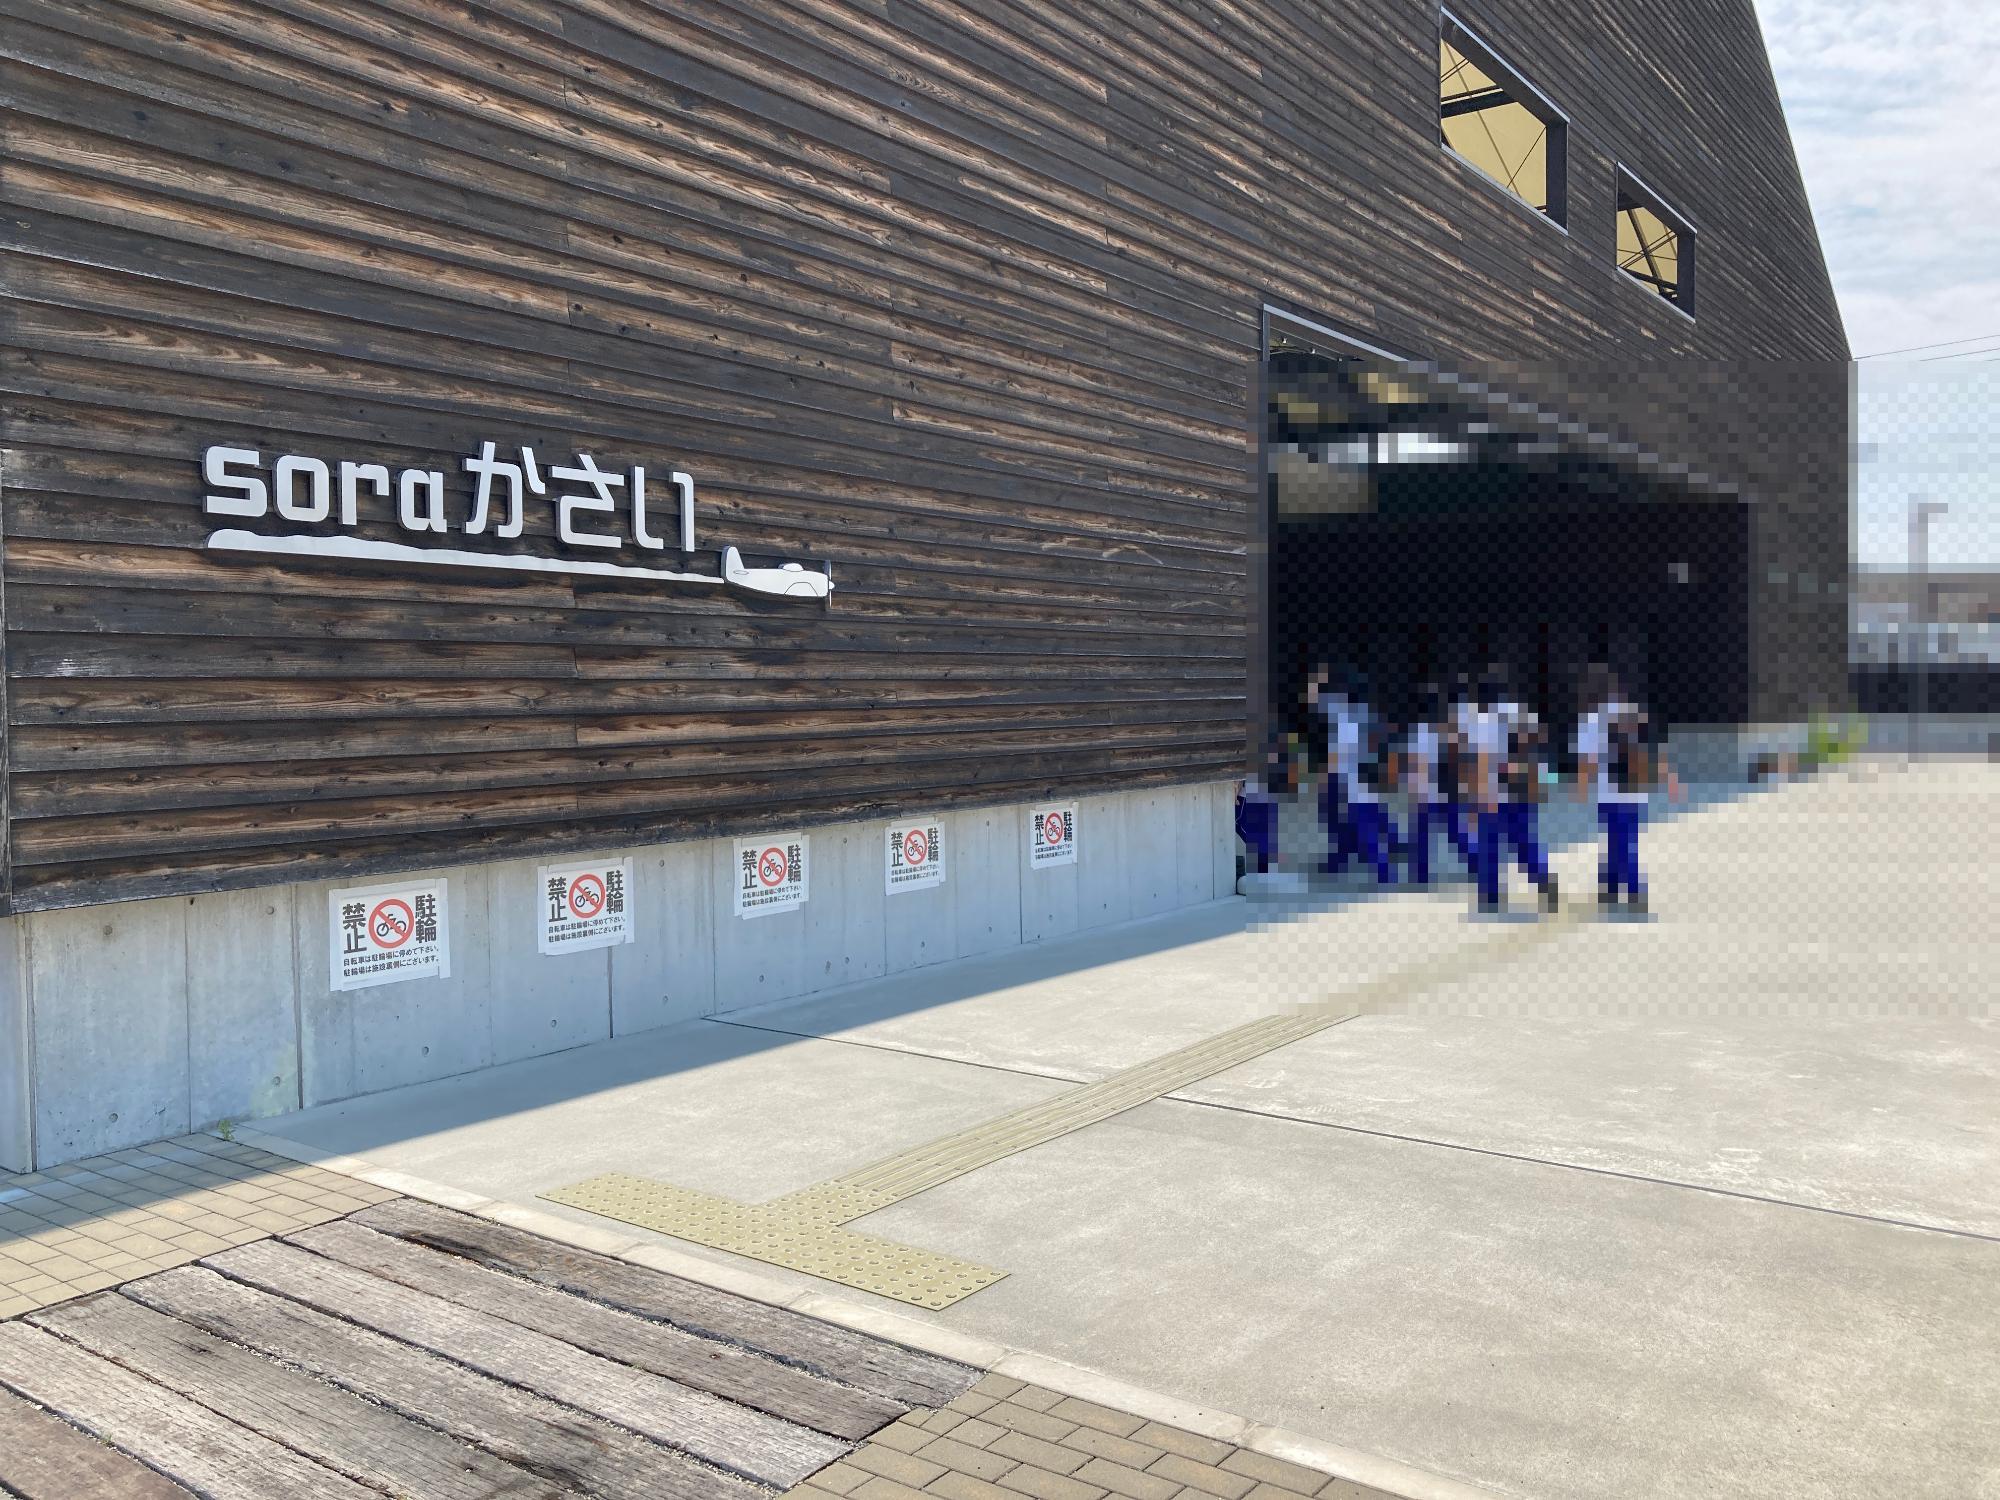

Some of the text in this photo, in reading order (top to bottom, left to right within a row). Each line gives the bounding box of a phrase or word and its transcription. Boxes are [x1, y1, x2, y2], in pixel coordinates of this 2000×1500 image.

[928, 827, 939, 862] 駐輪
[1035, 814, 1044, 845] 禁止
[787, 844, 801, 883] 駐輪
[891, 832, 903, 867] 禁止
[742, 850, 757, 889] 禁止
[548, 876, 567, 923] 禁止
[606, 870, 624, 914] 駐輪
[342, 902, 367, 954] 禁止
[415, 893, 437, 944] 駐輪
